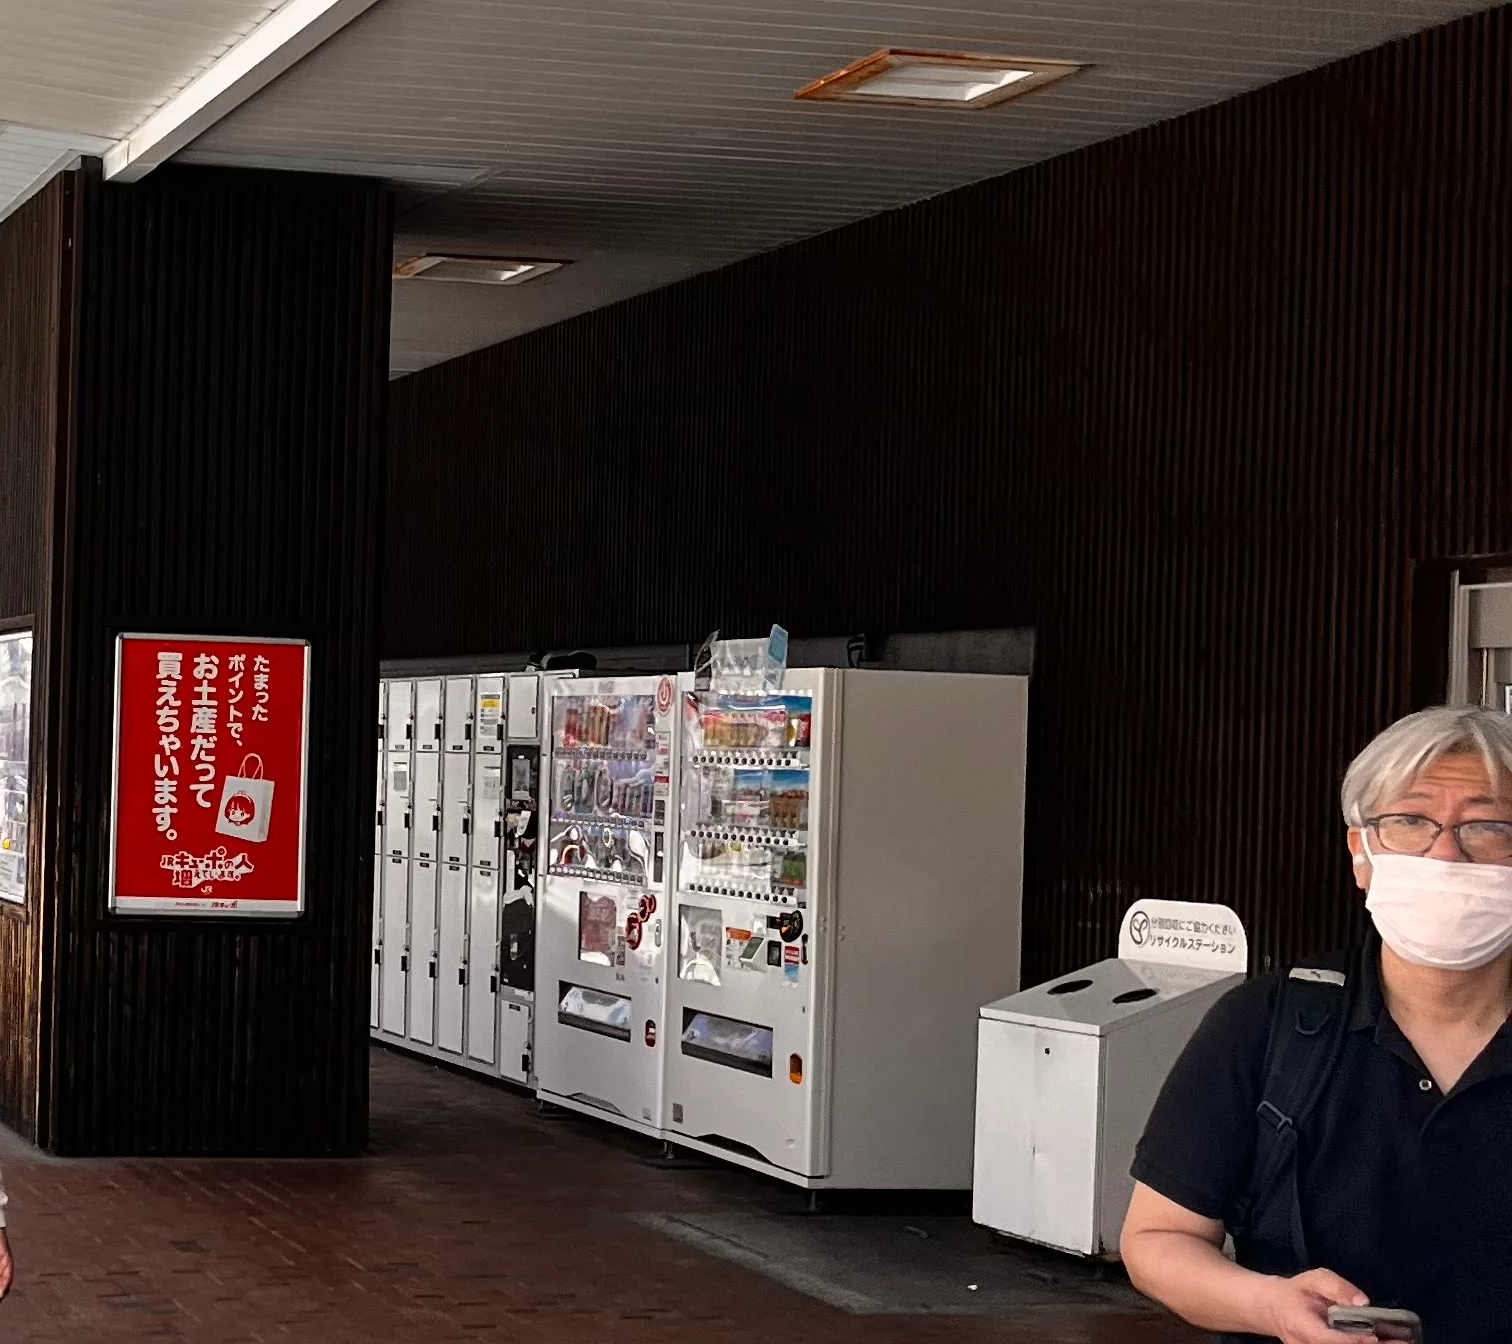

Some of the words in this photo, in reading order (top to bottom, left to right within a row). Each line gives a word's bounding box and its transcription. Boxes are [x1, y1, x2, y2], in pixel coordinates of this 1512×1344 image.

[189, 653, 219, 808] お土産だって
[226, 653, 246, 746] ポイントで、
[251, 654, 270, 722] たまった
[151, 651, 183, 841] 買えちゃいます。
[1149, 934, 1235, 954] リサイクルステーション
